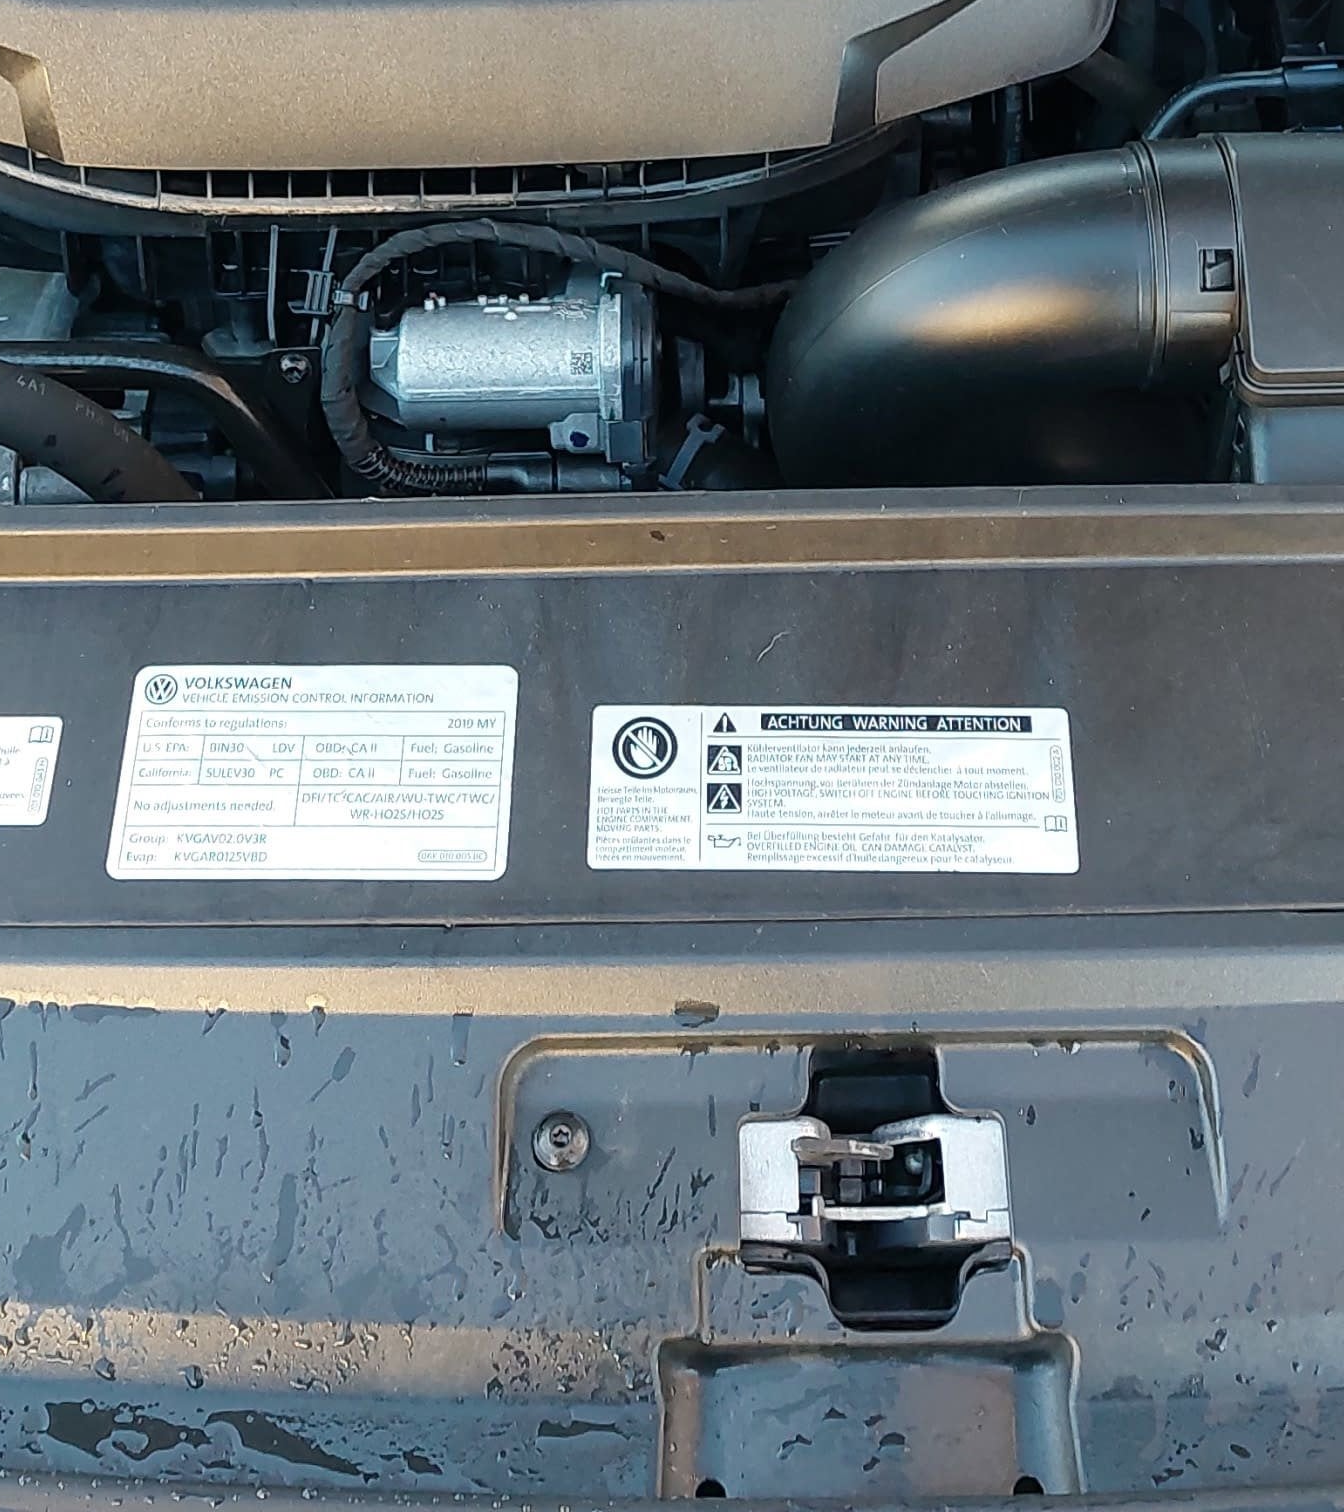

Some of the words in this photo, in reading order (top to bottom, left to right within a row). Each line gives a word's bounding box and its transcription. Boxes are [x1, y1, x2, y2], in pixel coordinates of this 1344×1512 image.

[185, 677, 292, 689] VOLKSWAGEN
[182, 693, 228, 703] VEHICLE
[232, 693, 289, 703] EMISSION
[292, 693, 347, 704] CONTROL
[351, 693, 434, 704] INFORMATION
[146, 717, 201, 728] Conforms
[205, 718, 216, 727] to
[219, 718, 287, 730] regulations:
[448, 718, 473, 728] 2019
[477, 718, 496, 728] MY
[767, 715, 843, 730] ACHTUNG
[852, 716, 928, 730] WARNING
[936, 716, 1021, 732] ATTENTION
[210, 743, 244, 752] BIN30
[272, 743, 295, 752] LDV
[351, 743, 367, 753] CA
[444, 743, 494, 753] Gasoline
[822, 744, 845, 753] kann
[747, 754, 792, 763] RADIATOR
[796, 754, 813, 763] FAN
[816, 754, 837, 763] MAY
[839, 754, 866, 763] START
[869, 754, 880, 763] AT
[883, 754, 901, 763] ANY
[139, 767, 192, 777] California:
[206, 768, 255, 778] SULEV30
[269, 768, 285, 778] PC
[348, 768, 365, 778] CA
[408, 768, 436, 778] Fuel:
[442, 768, 493, 778] Gasoline
[878, 789, 913, 798] ENGINE
[1007, 791, 1050, 800] IGNITION
[134, 800, 150, 811] No
[153, 800, 226, 813] adjustments
[911, 833, 928, 841] den
[862, 843, 882, 851] CAN
